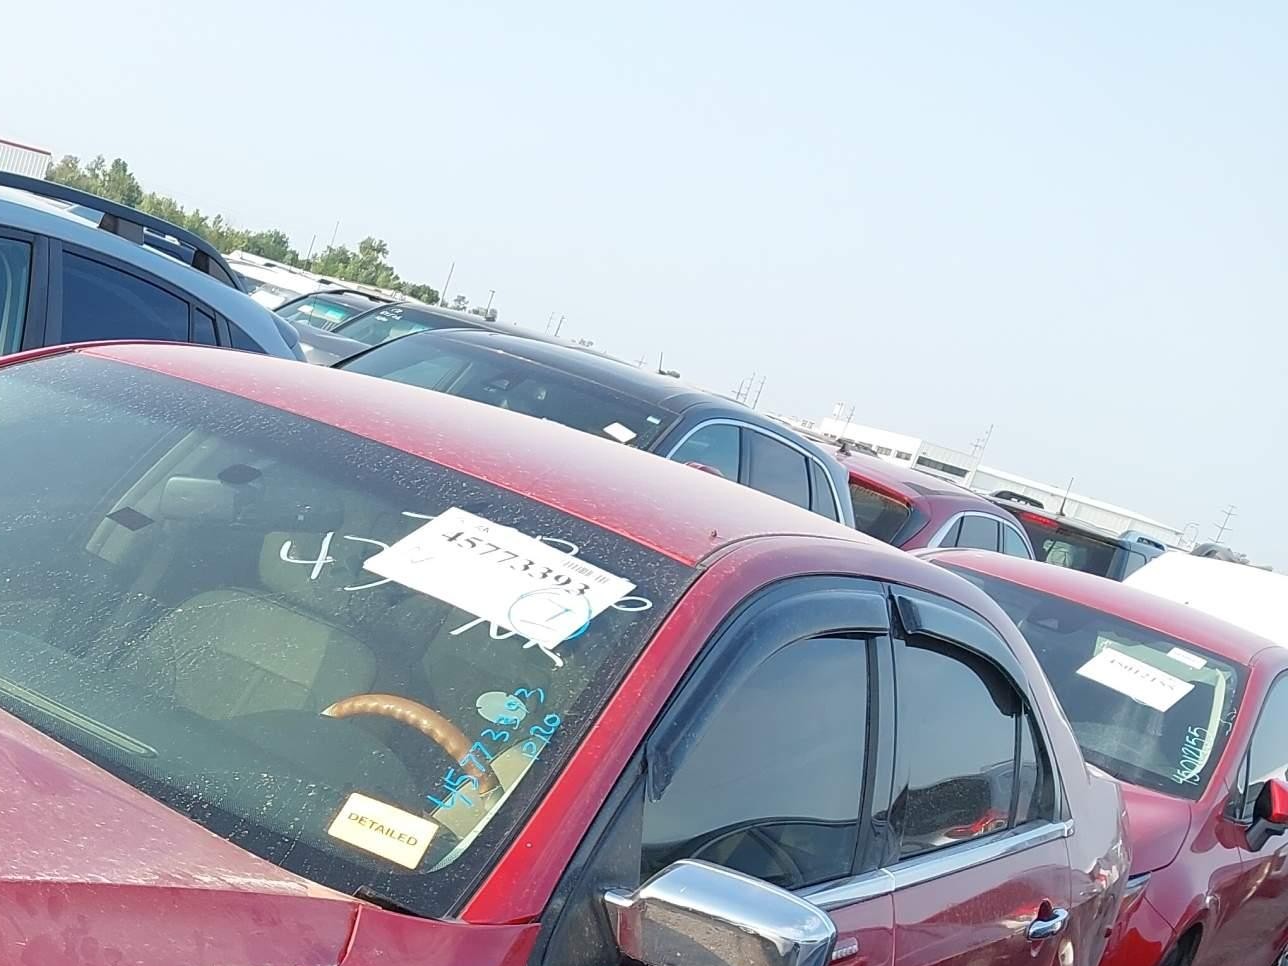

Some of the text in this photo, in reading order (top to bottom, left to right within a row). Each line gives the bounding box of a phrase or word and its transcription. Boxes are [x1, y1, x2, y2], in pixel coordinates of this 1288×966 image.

[442, 531, 591, 596] 45773393
[427, 687, 545, 809] 45773393
[347, 812, 419, 847] DETAILED
